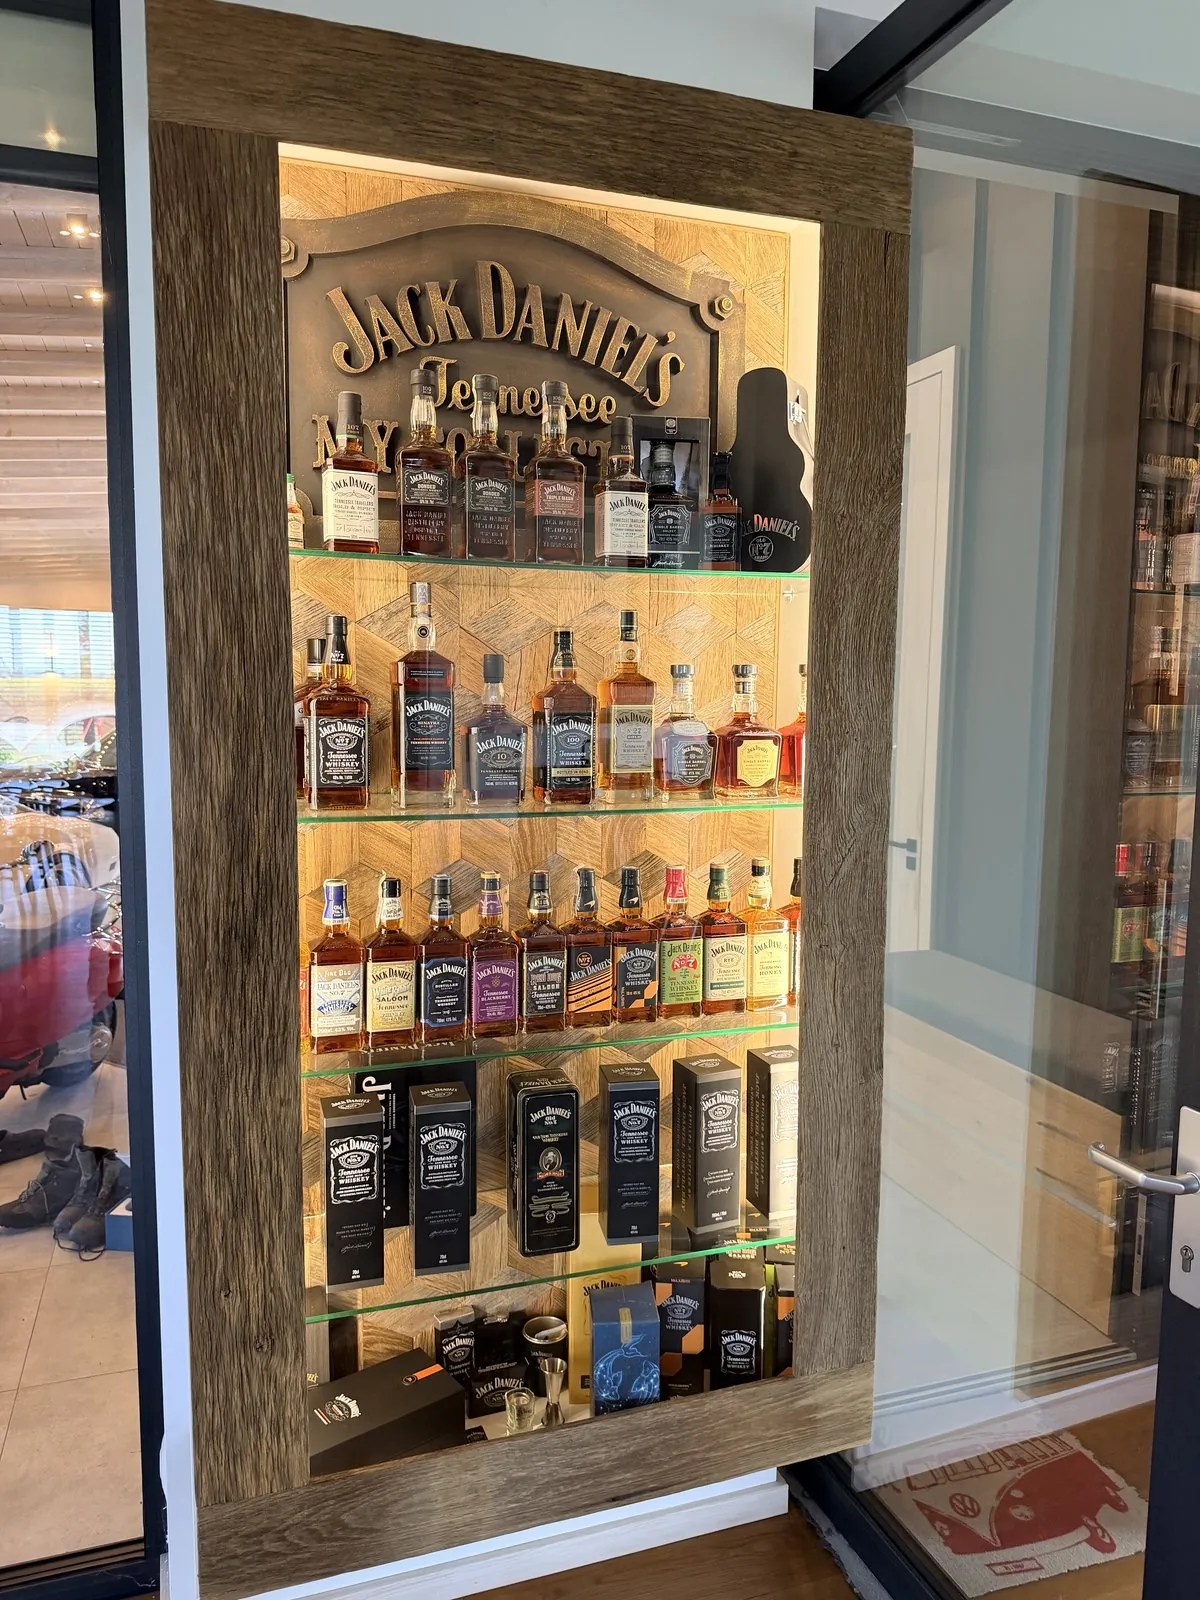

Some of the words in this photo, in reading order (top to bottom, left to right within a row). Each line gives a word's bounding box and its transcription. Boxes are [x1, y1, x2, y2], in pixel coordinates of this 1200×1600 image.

[325, 278, 473, 376] JACK
[476, 259, 686, 408] DANIEL'S
[347, 423, 359, 431] 107
[330, 478, 349, 493] JACK
[349, 475, 376, 496] DANIEL'S
[409, 472, 423, 485] JACK
[423, 471, 445, 487] DANIEL'S
[474, 482, 488, 492] JACK
[488, 479, 509, 494] DANIEL'S
[544, 486, 557, 496] JACK
[557, 483, 577, 498] DANIEL'S
[609, 500, 625, 512] JACK
[658, 511, 667, 519] JACK
[704, 519, 716, 529] JACK
[717, 516, 737, 529] DANIEL'S
[753, 513, 801, 542] DANIEL'S
[405, 703, 424, 717] JACK
[424, 699, 452, 719] DANIEL'S
[318, 722, 338, 738] JACK
[337, 721, 366, 738] DANIEL'S
[552, 723, 569, 736] JACK
[614, 717, 630, 728] JACK
[476, 739, 497, 754] JACK
[497, 735, 525, 754] DANIEL'S
[326, 751, 358, 760] Tennessee
[620, 950, 635, 963] JACK
[635, 947, 657, 962] DANIEL'S
[667, 943, 682, 957] Jack
[711, 945, 726, 958] JACK
[754, 941, 768, 955] JACK
[426, 966, 443, 979] JACK
[442, 963, 467, 978] DANIEL'S
[528, 959, 543, 972] JACK
[542, 956, 565, 969] DANIEL'S
[570, 968, 587, 982] JACK
[586, 958, 613, 976] DANIEL'S
[371, 970, 388, 984] JACK
[388, 968, 414, 982] DANIEL'S
[476, 967, 492, 981] JACK
[491, 964, 516, 978] DANIEL'S
[626, 971, 651, 979] Tennessee
[625, 979, 653, 987] WHISKEY
[670, 984, 699, 992] WHISKEY
[376, 995, 409, 1003] SALOON
[483, 989, 509, 997] Tennessee
[531, 991, 561, 999] Tennessee
[701, 1098, 717, 1111] JACK
[716, 1093, 740, 1107] DANIEL'S
[530, 1108, 546, 1123] JACK
[546, 1106, 572, 1119] DANIEL'S
[613, 1107, 631, 1120] JACK
[630, 1103, 657, 1119] DANIEL'S
[707, 1118, 733, 1127] Tennessee
[419, 1130, 438, 1145] JACK
[438, 1126, 467, 1141] DANIEL'S
[708, 1126, 733, 1135] WHISKEY
[329, 1144, 349, 1159] JACK
[349, 1138, 380, 1154] DANIEL'S
[427, 1154, 459, 1162] Tennessee
[338, 1167, 371, 1177] Tennessee
[427, 1162, 458, 1170] WHISKEY
[338, 1176, 370, 1185] WHISKEY
[661, 1297, 676, 1307] JACK
[676, 1294, 700, 1310] DANIEL'S
[721, 1334, 735, 1346] JACK
[735, 1332, 757, 1347] DANIEL'S
[442, 1341, 455, 1354] JACK
[726, 1355, 751, 1363] Tennessee
[475, 1382, 493, 1399] JACK
[493, 1376, 525, 1390] DANIEL'S
